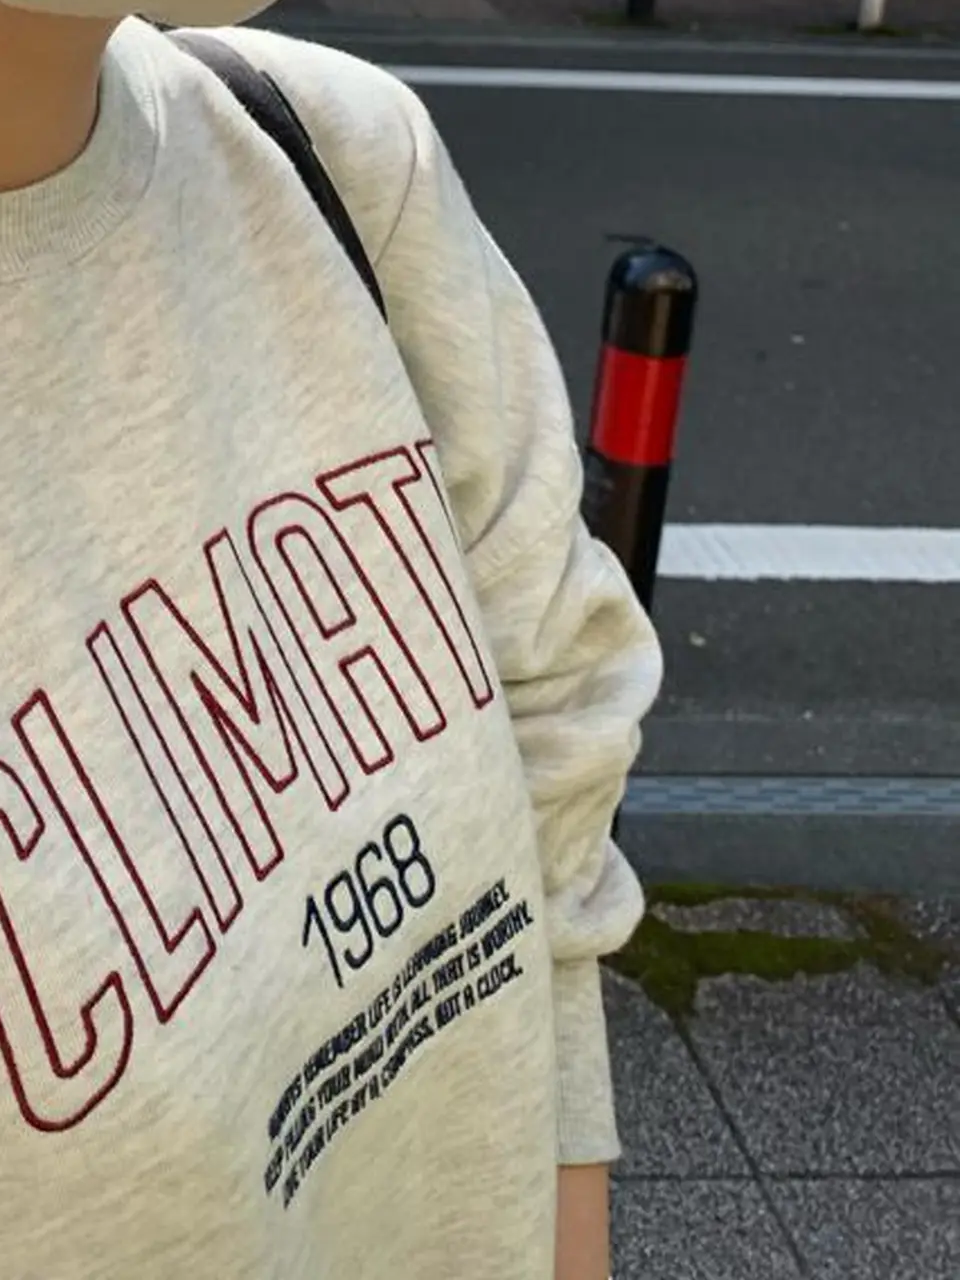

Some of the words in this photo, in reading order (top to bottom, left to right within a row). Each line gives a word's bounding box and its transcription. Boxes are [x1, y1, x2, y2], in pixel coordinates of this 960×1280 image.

[301, 813, 437, 988] 1968
[367, 987, 392, 1029] LIFE
[411, 980, 432, 1015] ALL
[432, 953, 464, 994] THAT
[466, 942, 481, 970] IS
[326, 1100, 350, 1142] LIFE
[435, 991, 461, 1029] NOT
[463, 983, 475, 1010] A
